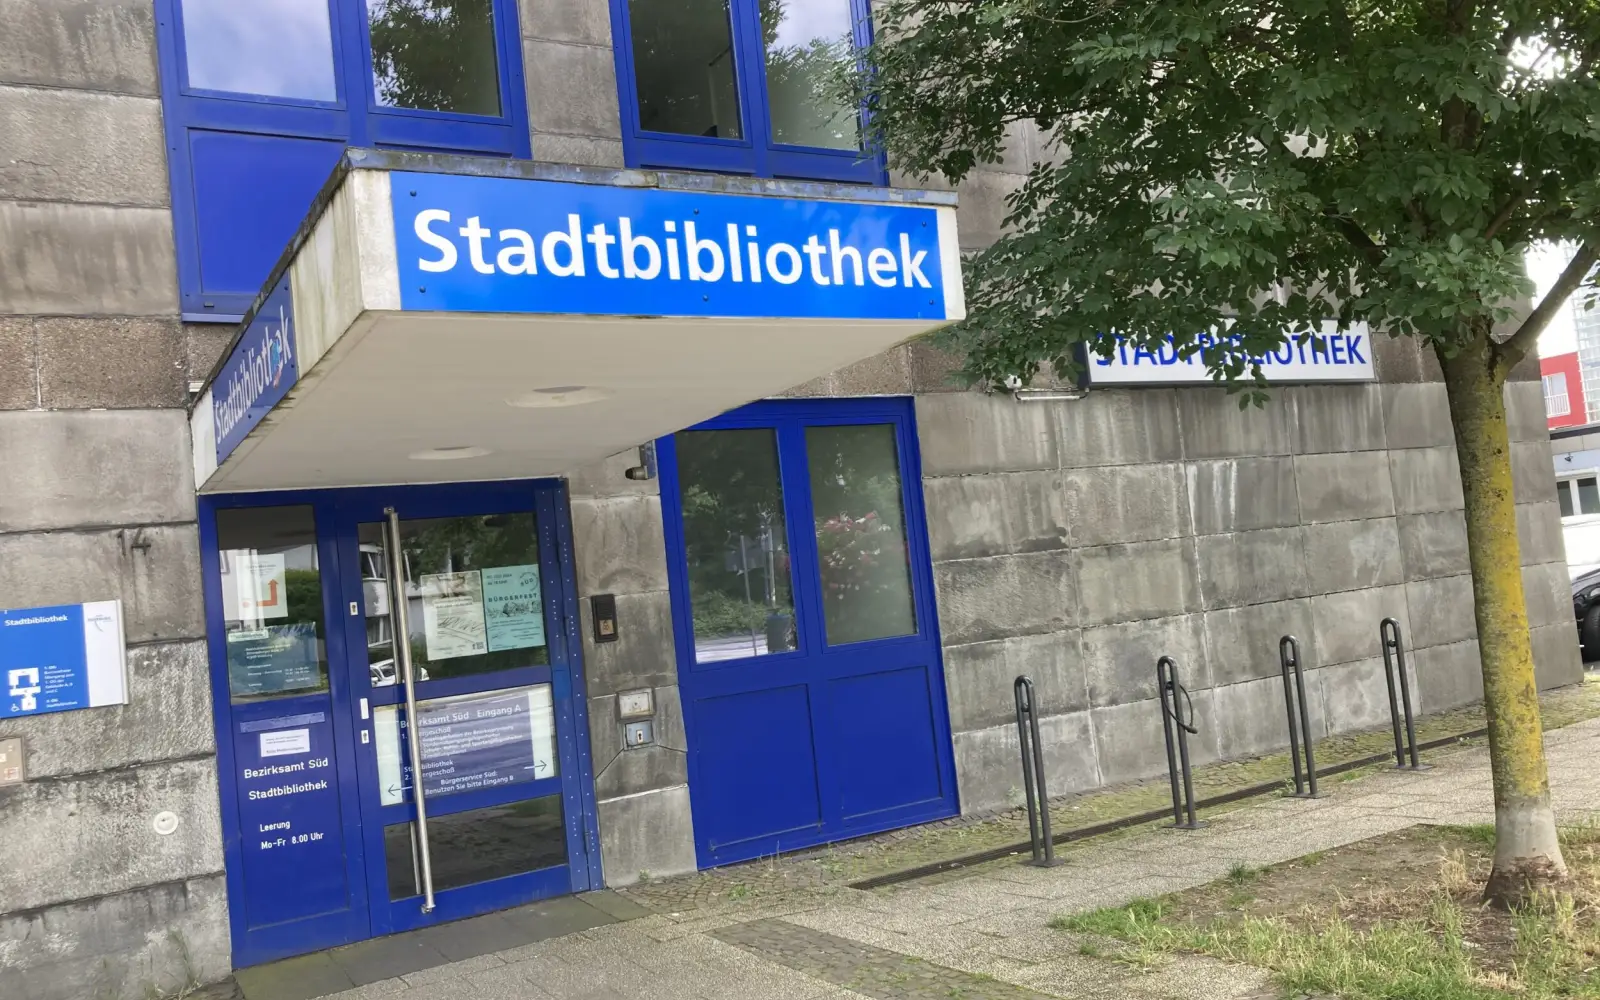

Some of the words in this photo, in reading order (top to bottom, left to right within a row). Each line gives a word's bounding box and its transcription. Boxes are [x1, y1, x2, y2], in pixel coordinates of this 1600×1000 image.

[413, 208, 933, 289] Stadtbibliothek
[1095, 331, 1367, 366] TADOTHEK
[4, 614, 68, 627] Stadtbibliothek
[400, 714, 451, 728] Brksamt
[452, 711, 469, 721] Süd
[476, 707, 512, 718] Eingang
[514, 704, 521, 712] A
[244, 761, 305, 779] Bezirksamt
[308, 757, 329, 769] Süd
[404, 760, 454, 772] Stabibliothek
[425, 786, 455, 795] Benutzen
[466, 780, 482, 788] bitte
[483, 776, 508, 785] Eingang
[440, 773, 483, 785] Bürgerservice
[248, 780, 328, 800] Stadtbibliothek
[260, 821, 291, 832] Leerung
[261, 838, 286, 849] Mo-Fr
[291, 834, 309, 844] 8.00
[310, 832, 324, 841] Uhr
